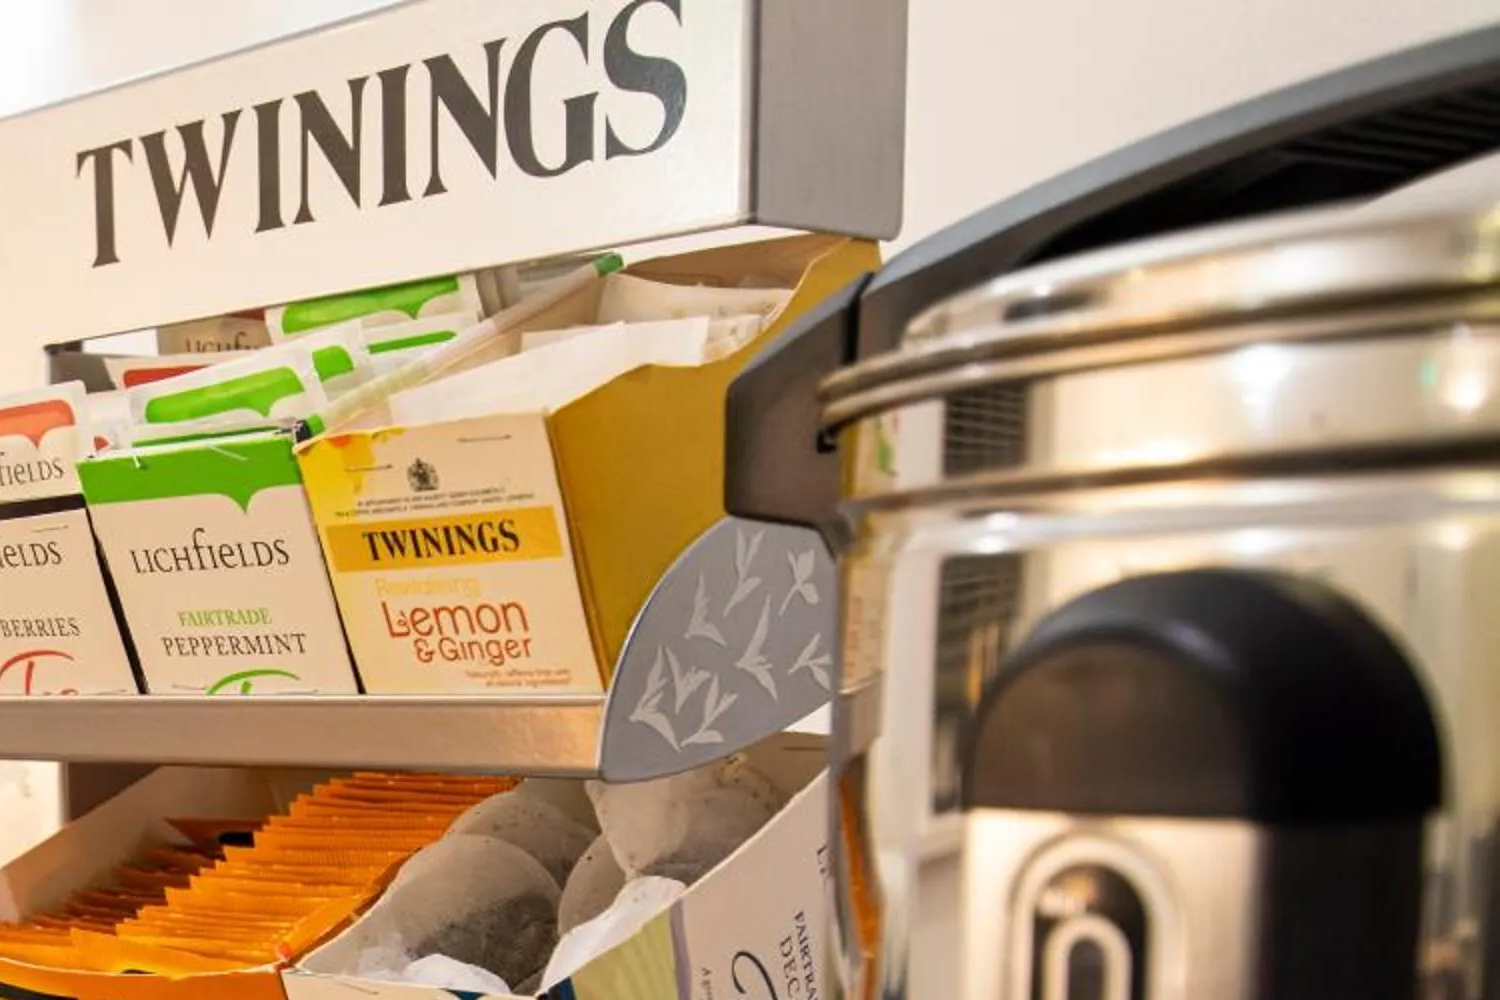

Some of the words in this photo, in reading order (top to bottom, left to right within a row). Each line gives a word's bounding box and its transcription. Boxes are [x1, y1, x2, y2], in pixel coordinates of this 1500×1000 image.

[76, 0, 688, 268] TWININGS
[362, 519, 520, 561] TWININGS
[177, 607, 273, 628] FAIRTRADE
[380, 601, 529, 638] Lemon
[160, 633, 308, 656] PEPPERMINT
